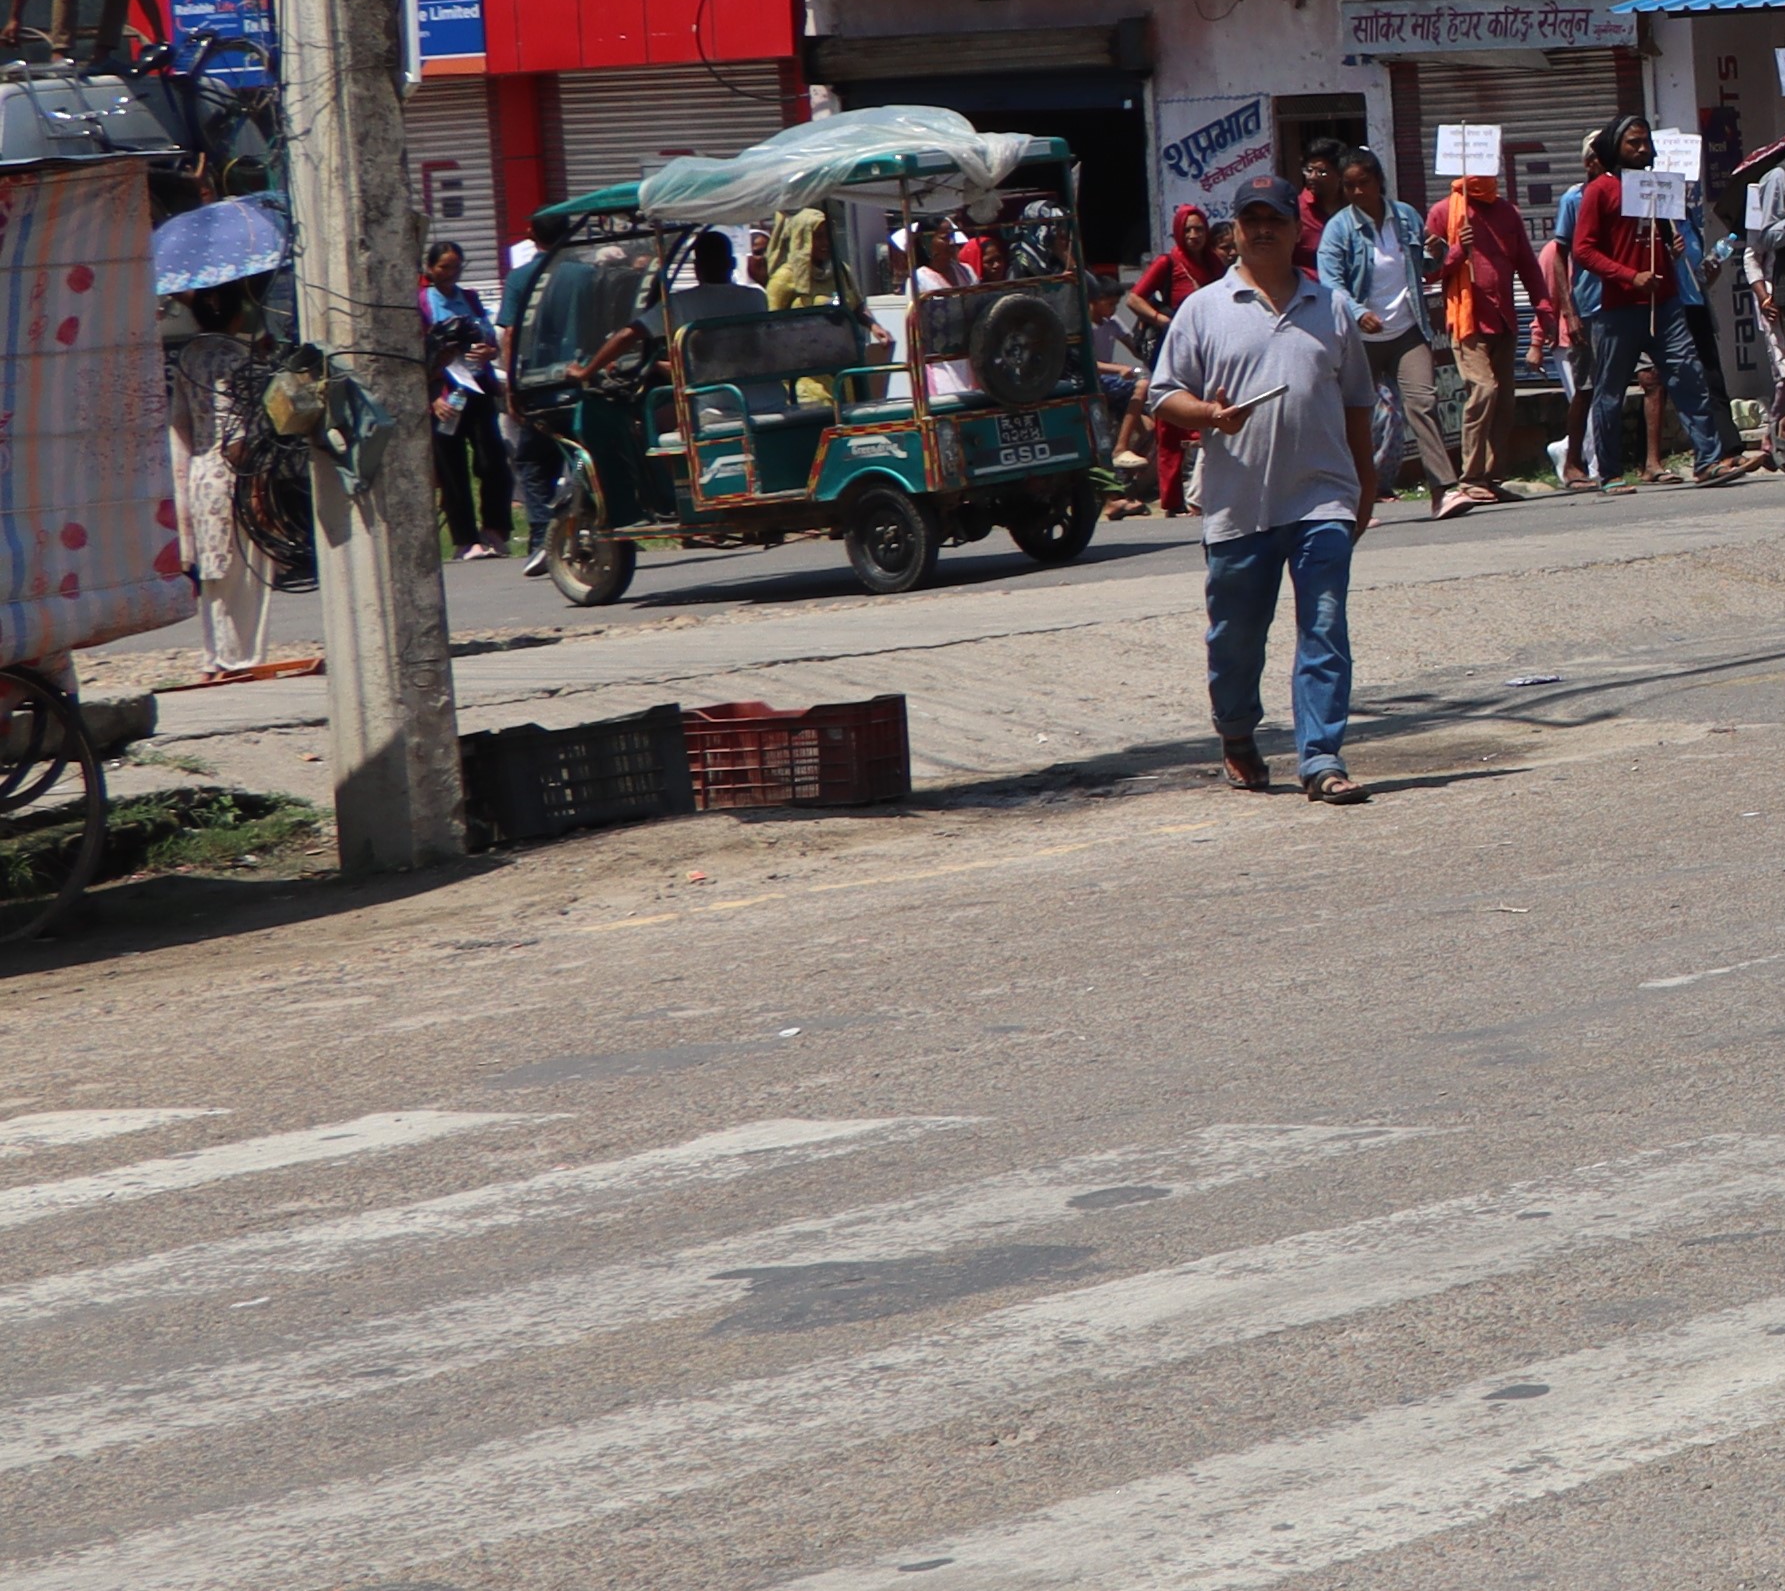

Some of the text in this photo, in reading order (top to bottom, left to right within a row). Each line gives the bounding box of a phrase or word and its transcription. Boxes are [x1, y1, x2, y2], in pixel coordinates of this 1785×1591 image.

[174, 2, 216, 16] Reliable
[429, 4, 480, 21] Limited
[1538, 0, 1594, 45] सैलुन
[999, 443, 1051, 466] GSD
